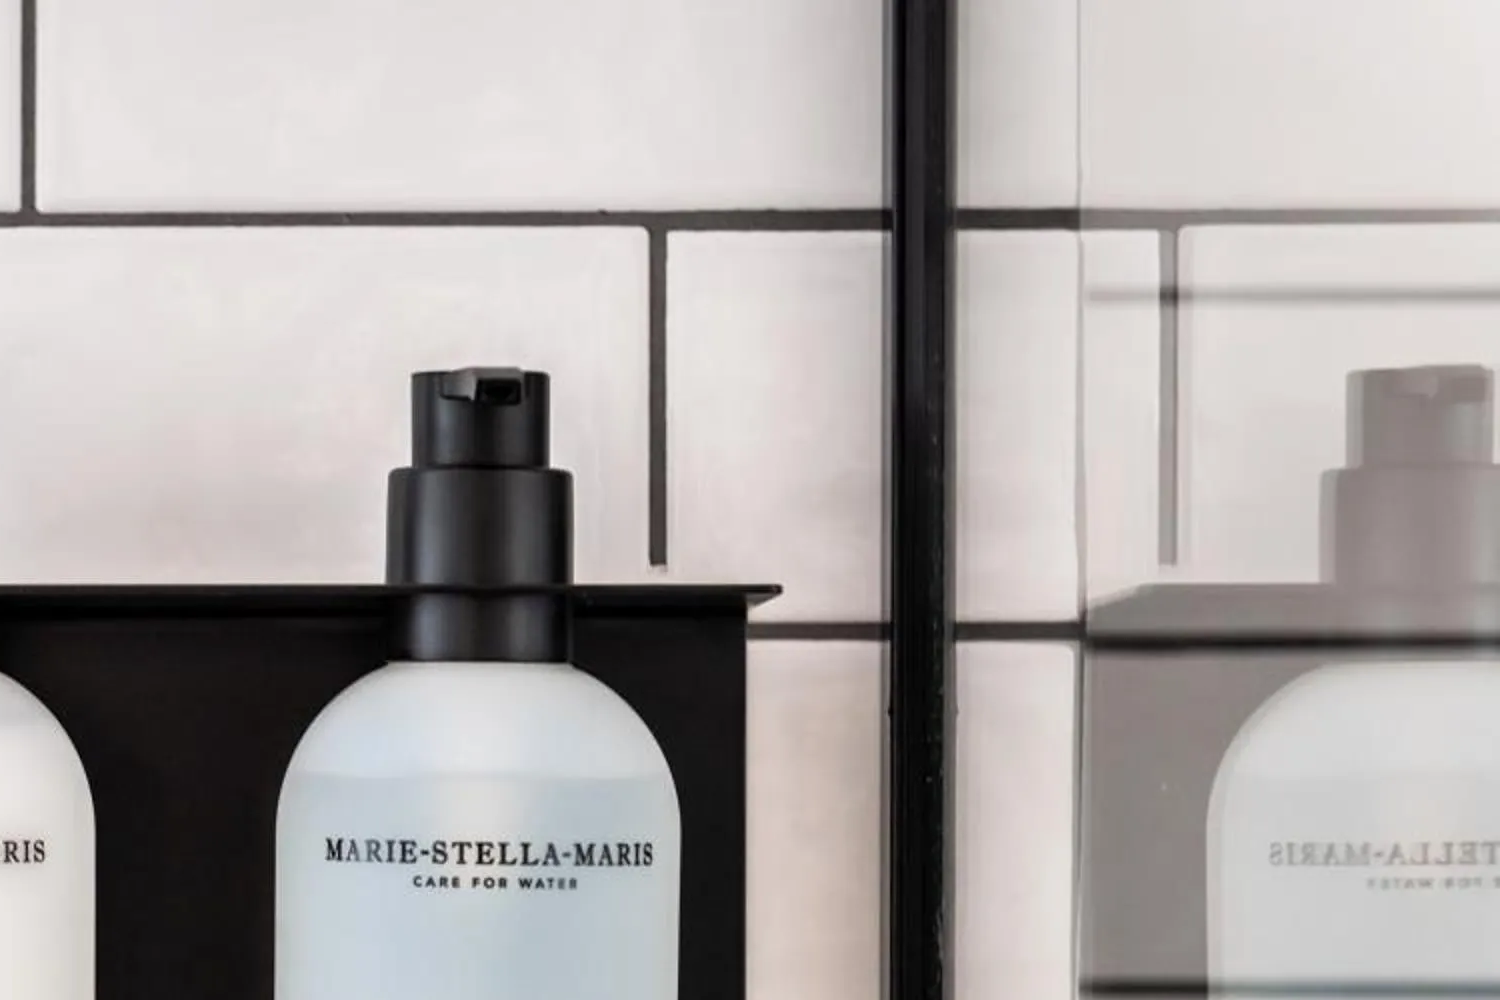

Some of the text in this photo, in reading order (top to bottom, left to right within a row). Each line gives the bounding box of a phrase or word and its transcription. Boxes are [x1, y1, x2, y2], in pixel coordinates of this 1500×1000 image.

[325, 837, 654, 867] MARIE-STELLA-MARIS
[412, 875, 578, 890] CARE FOR WATER
